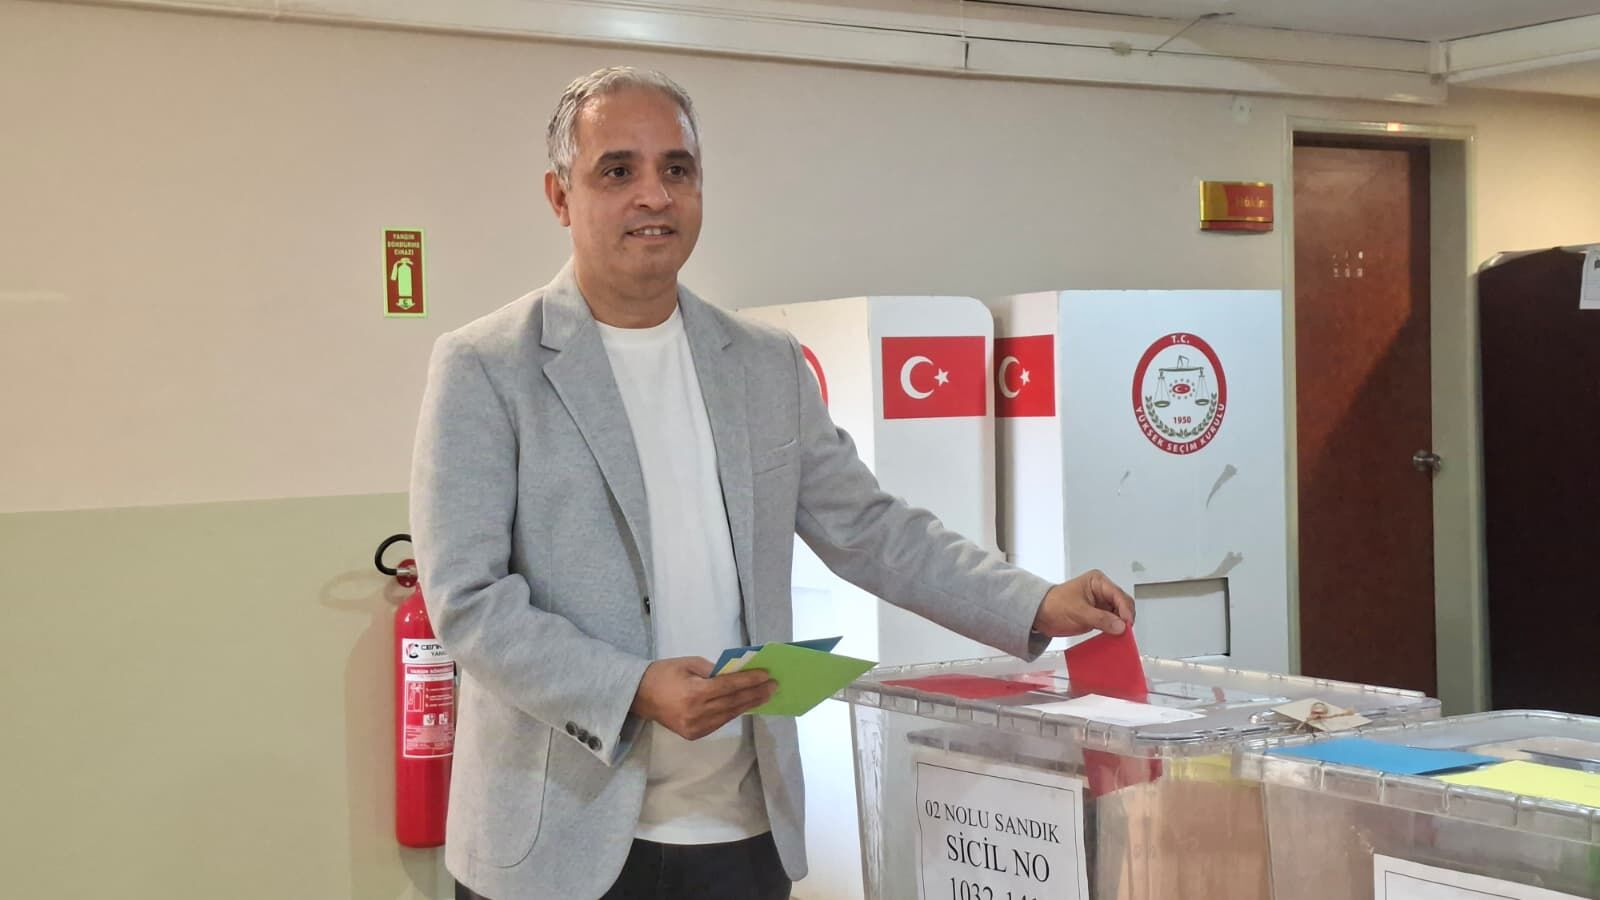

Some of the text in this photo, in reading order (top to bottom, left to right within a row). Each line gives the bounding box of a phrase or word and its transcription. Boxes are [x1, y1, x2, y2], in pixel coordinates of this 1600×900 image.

[1171, 334, 1190, 344] T.C.
[1136, 403, 1225, 454] YÜKSEK SEÇİM KURULU
[1173, 416, 1192, 425] 1950
[925, 799, 1061, 845] 02 NOLU SANDIK
[946, 832, 1050, 883] SİCİL NO
